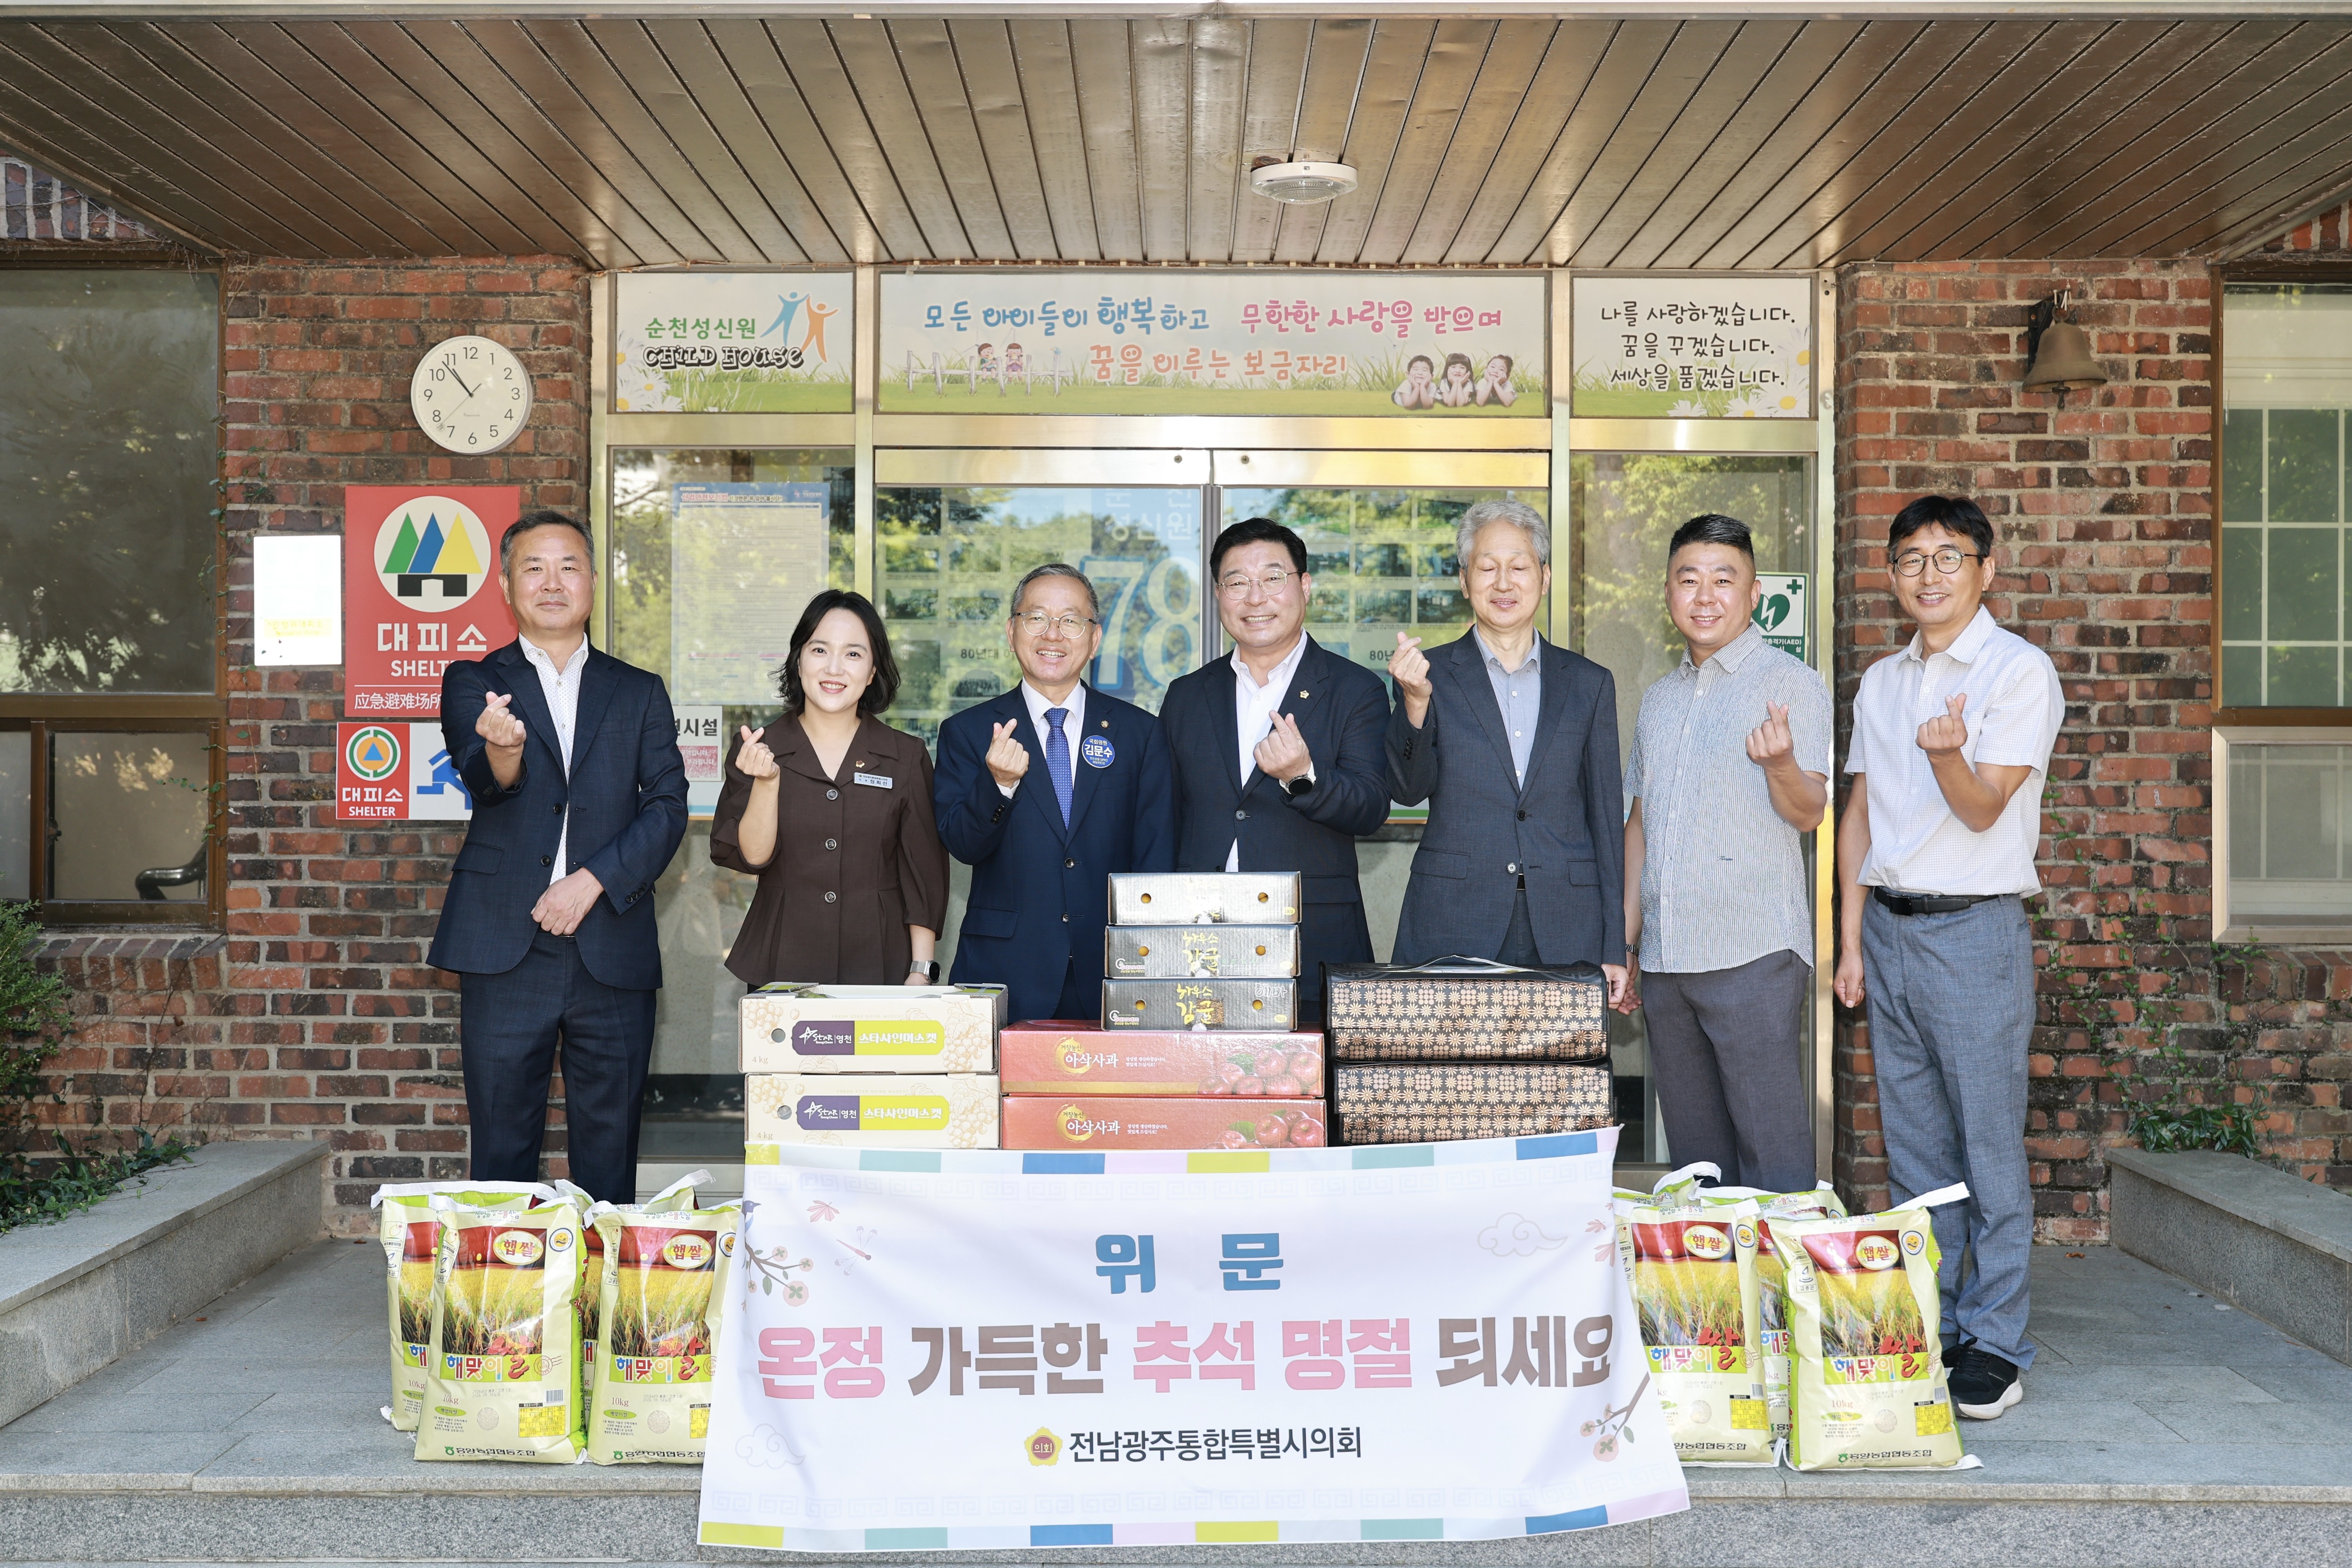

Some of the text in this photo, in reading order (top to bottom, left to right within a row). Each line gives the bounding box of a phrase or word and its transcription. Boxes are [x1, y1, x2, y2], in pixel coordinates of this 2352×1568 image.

[925, 296, 1501, 338] 모든 아이들이 행복하고 무한한 사랑을 받으며
[1601, 301, 1795, 327] 나를 사랑하겠습니다.
[645, 318, 755, 340] 순천성신원
[1621, 332, 1775, 358] 꿈을 꾸겠습니다.
[445, 353, 456, 365] 11
[463, 347, 478, 359] 12
[489, 353, 494, 365] 1
[1090, 344, 1346, 383] 꿈을 이루는 보금자리
[430, 369, 445, 381] 10
[503, 368, 512, 379] 2
[1610, 363, 1785, 389] 세상을 품겠습니다.
[424, 389, 432, 401] 9
[512, 387, 520, 400] 3
[432, 410, 441, 422] 8
[504, 409, 513, 421] 4
[447, 425, 455, 437] 7
[490, 425, 498, 437] 5
[468, 432, 477, 444] 6
[377, 623, 487, 652] 대피소
[1370, 650, 1394, 661] 80년
[390, 660, 455, 677] SHELT
[354, 693, 441, 710] 应急避难场所
[1084, 744, 1113, 758] 김문수
[342, 787, 403, 802] 대피소
[349, 806, 396, 816] SHELTER
[1182, 931, 1219, 946] 하우스
[1177, 983, 1212, 999] 하우스
[1176, 1000, 1215, 1024] 감귤
[836, 1035, 852, 1043] 영천
[859, 1033, 937, 1044] 스타샤인머스켓
[758, 1056, 768, 1065] kg
[1065, 1053, 1119, 1068] 아삭사과
[841, 1110, 856, 1119] 영천
[863, 1108, 942, 1119] 스타샤인머스켓
[1067, 1120, 1120, 1135] 아삭사과
[763, 1132, 773, 1140] kg
[503, 1239, 535, 1258] 햅쌀
[1693, 1234, 1722, 1251] 햅쌀
[673, 1244, 703, 1260] 햅쌀
[1863, 1246, 1890, 1261] 햅쌀
[1650, 1327, 1740, 1371] 해맞이쌀
[758, 1314, 1613, 1399] 온정 가득한 추석 명절 되세요
[1833, 1334, 1921, 1382] 해맞이쌀
[409, 1380, 425, 1390] 10kg
[1657, 1388, 1668, 1396] kg
[443, 1394, 459, 1405] 10kg
[612, 1397, 629, 1407] 10kg
[1832, 1400, 1853, 1408] 10kg
[1034, 1427, 1362, 1462] 의회 전남광주통합특별시의회
[1850, 1449, 1932, 1459] 흥양농업협동조합
